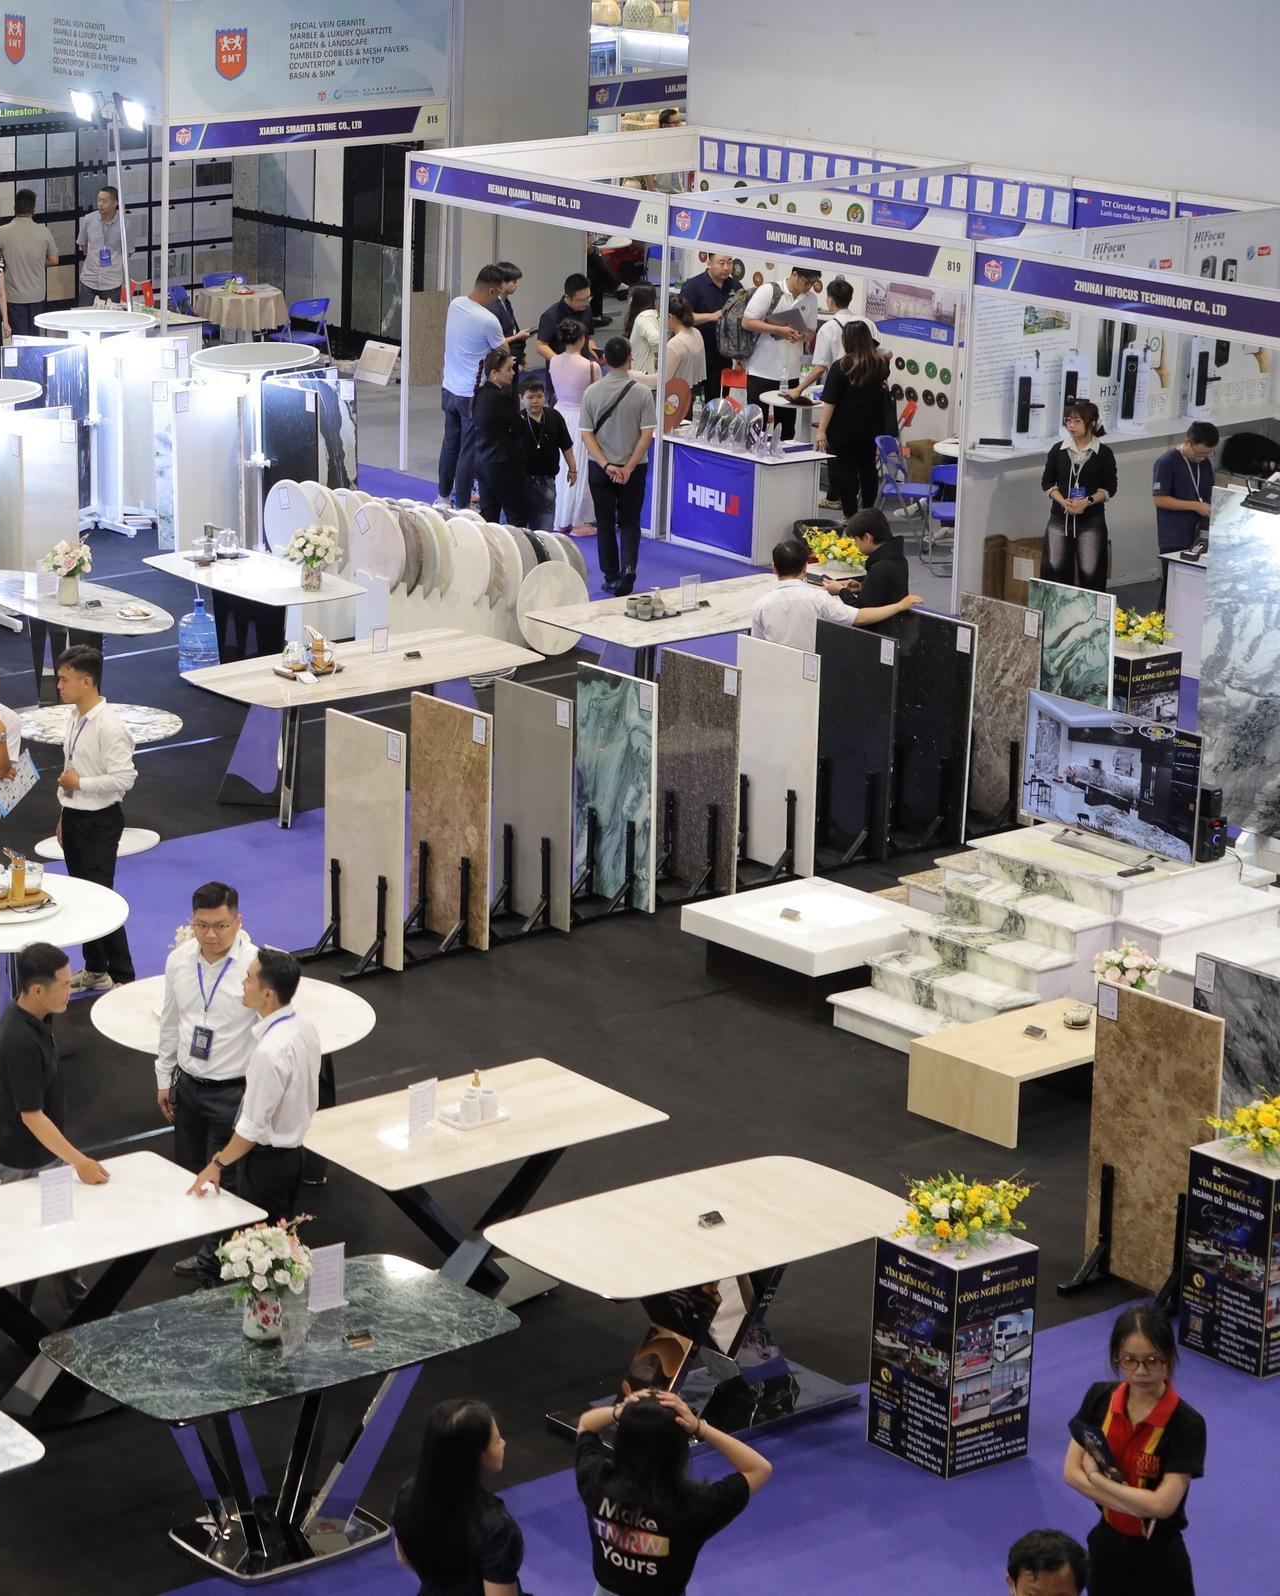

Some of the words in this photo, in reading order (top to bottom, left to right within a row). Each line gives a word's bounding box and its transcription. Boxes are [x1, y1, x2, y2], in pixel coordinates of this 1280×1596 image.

[290, 21, 317, 30] SPECIAL
[337, 19, 366, 27] GRANITE
[327, 29, 353, 37] LUXURY
[355, 27, 392, 36] QUARTZITE
[9, 39, 21, 48] SMT
[290, 42, 318, 50] GARDEN
[222, 53, 241, 64] SMT
[290, 51, 322, 60] TUMBLED
[324, 49, 353, 57] COBBLES
[363, 47, 381, 55] MESH
[289, 60, 335, 70] COUNTERTOP
[345, 58, 369, 66] VANITY
[289, 71, 310, 80] BASIN
[427, 114, 438, 125] 815
[259, 126, 285, 136] XIAMEN
[286, 123, 316, 134] SMARTER
[317, 122, 337, 132] STONE
[338, 120, 350, 131] CO.,
[351, 120, 362, 130] LTD
[488, 183, 507, 196] HENAN
[509, 187, 531, 201] QIANNA
[531, 192, 556, 206] TRADING
[558, 196, 569, 208] CO.,
[570, 198, 581, 210] LTD
[1101, 200, 1113, 208] TCT
[1112, 200, 1136, 212] Circular
[1136, 203, 1150, 214] Saw
[1151, 206, 1168, 216] Blade
[646, 213, 658, 224] 818
[1194, 230, 1226, 243] HiFocus
[766, 230, 797, 245] DANYANG
[798, 235, 812, 247] AVA
[813, 238, 834, 251] TOOLS
[835, 243, 849, 254] CO.,
[850, 245, 862, 256] LTD
[1092, 242, 1126, 255] HiFocus
[947, 261, 961, 272] 819
[1074, 280, 1103, 296] ZHUHAI
[1105, 284, 1139, 302] HIFOCUS
[1140, 291, 1193, 311] TECHNOLOGY
[1194, 300, 1210, 315] CO.,
[1212, 303, 1228, 316] LTD
[600, 1540, 658, 1576] Yours
